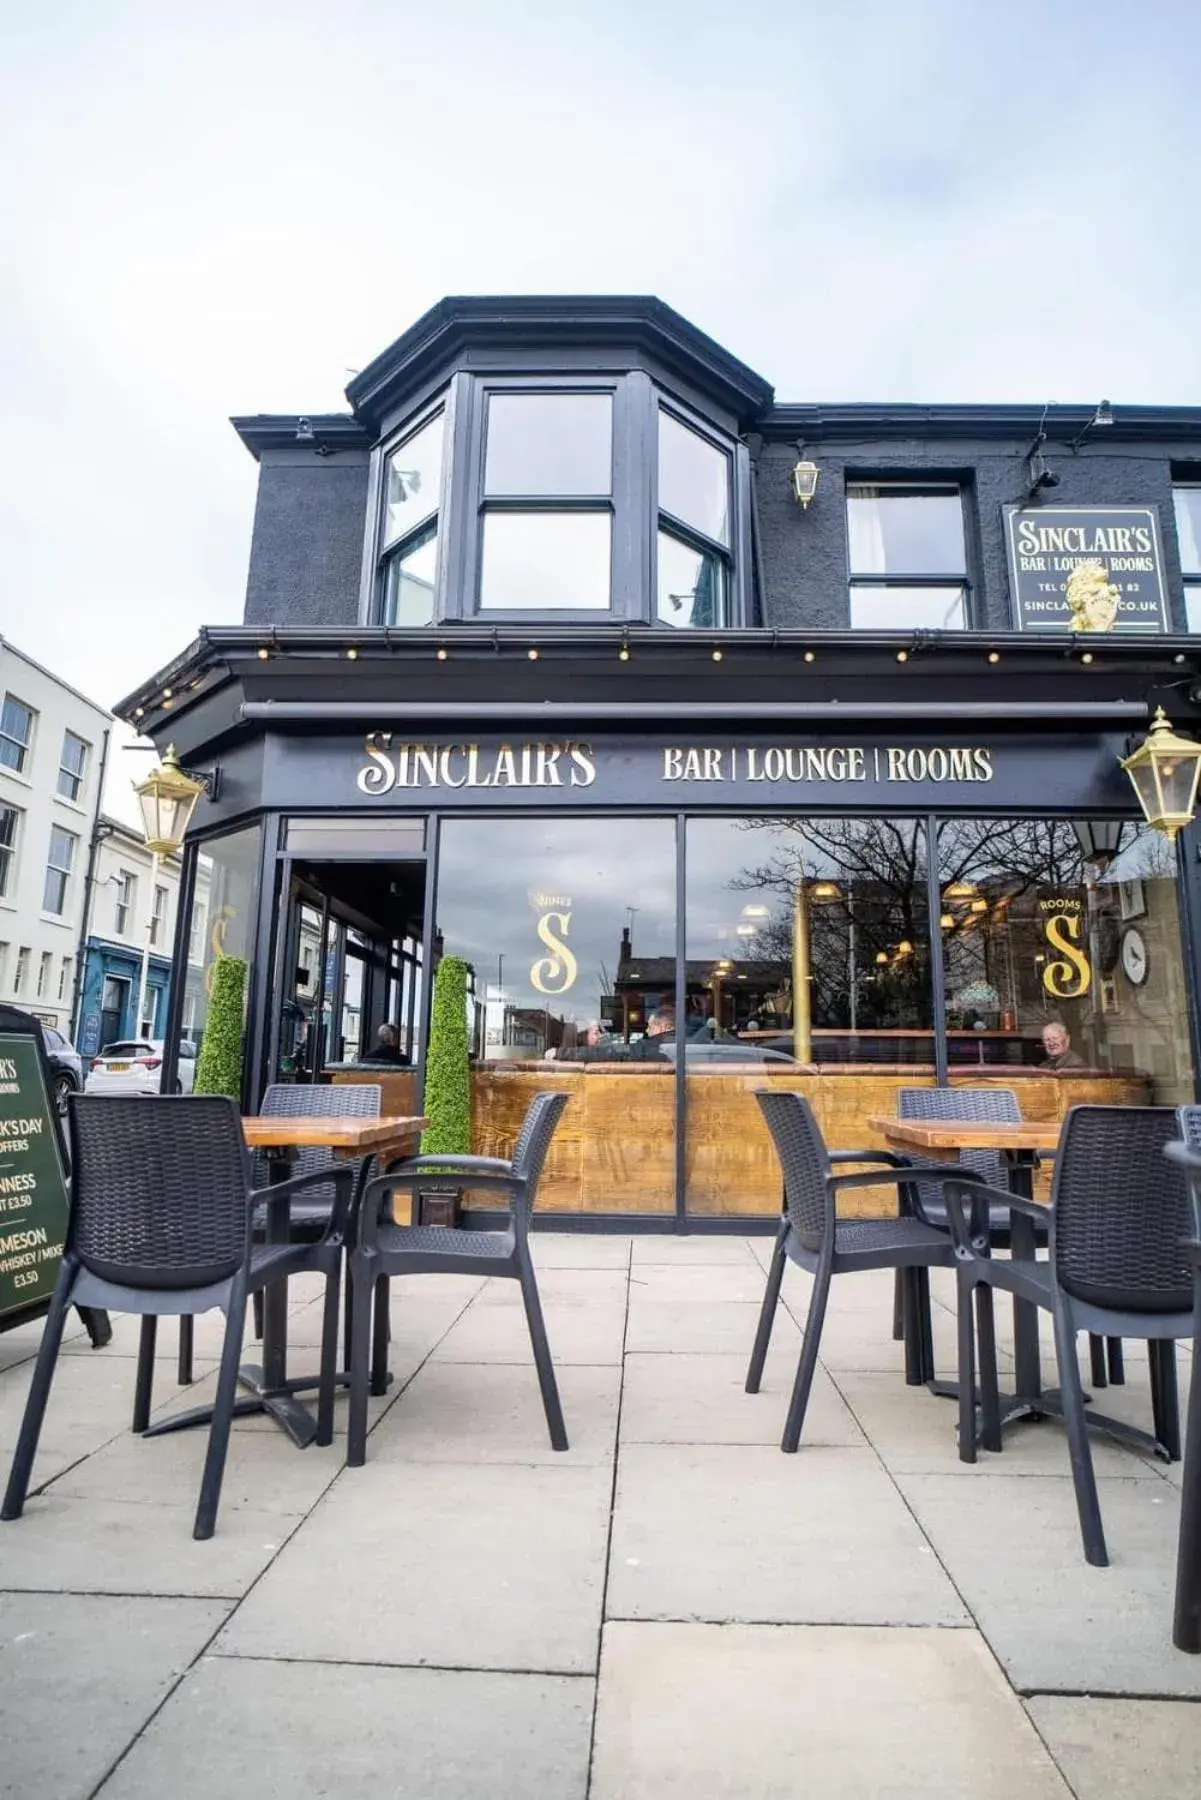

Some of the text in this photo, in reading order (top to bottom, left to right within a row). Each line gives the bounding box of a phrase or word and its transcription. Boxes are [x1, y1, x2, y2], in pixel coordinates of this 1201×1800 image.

[1018, 520, 1151, 556] SINCLAIR'S
[1020, 557, 1047, 571] BAR
[1110, 557, 1154, 572] ROOMS
[1038, 583, 1058, 592] TEL
[357, 730, 596, 796] SINCLAIR'S
[662, 748, 993, 782] BAR LOUNGE ROOMS
[1040, 899, 1081, 911] ROOMS
[530, 911, 577, 994] S
[1043, 915, 1091, 998] S
[0, 1058, 17, 1079] R'S
[0, 1118, 43, 1136] K'S DAY
[0, 1173, 36, 1193] NNESS
[0, 1227, 47, 1254] AMESON
[42, 1243, 65, 1260] MIXE
